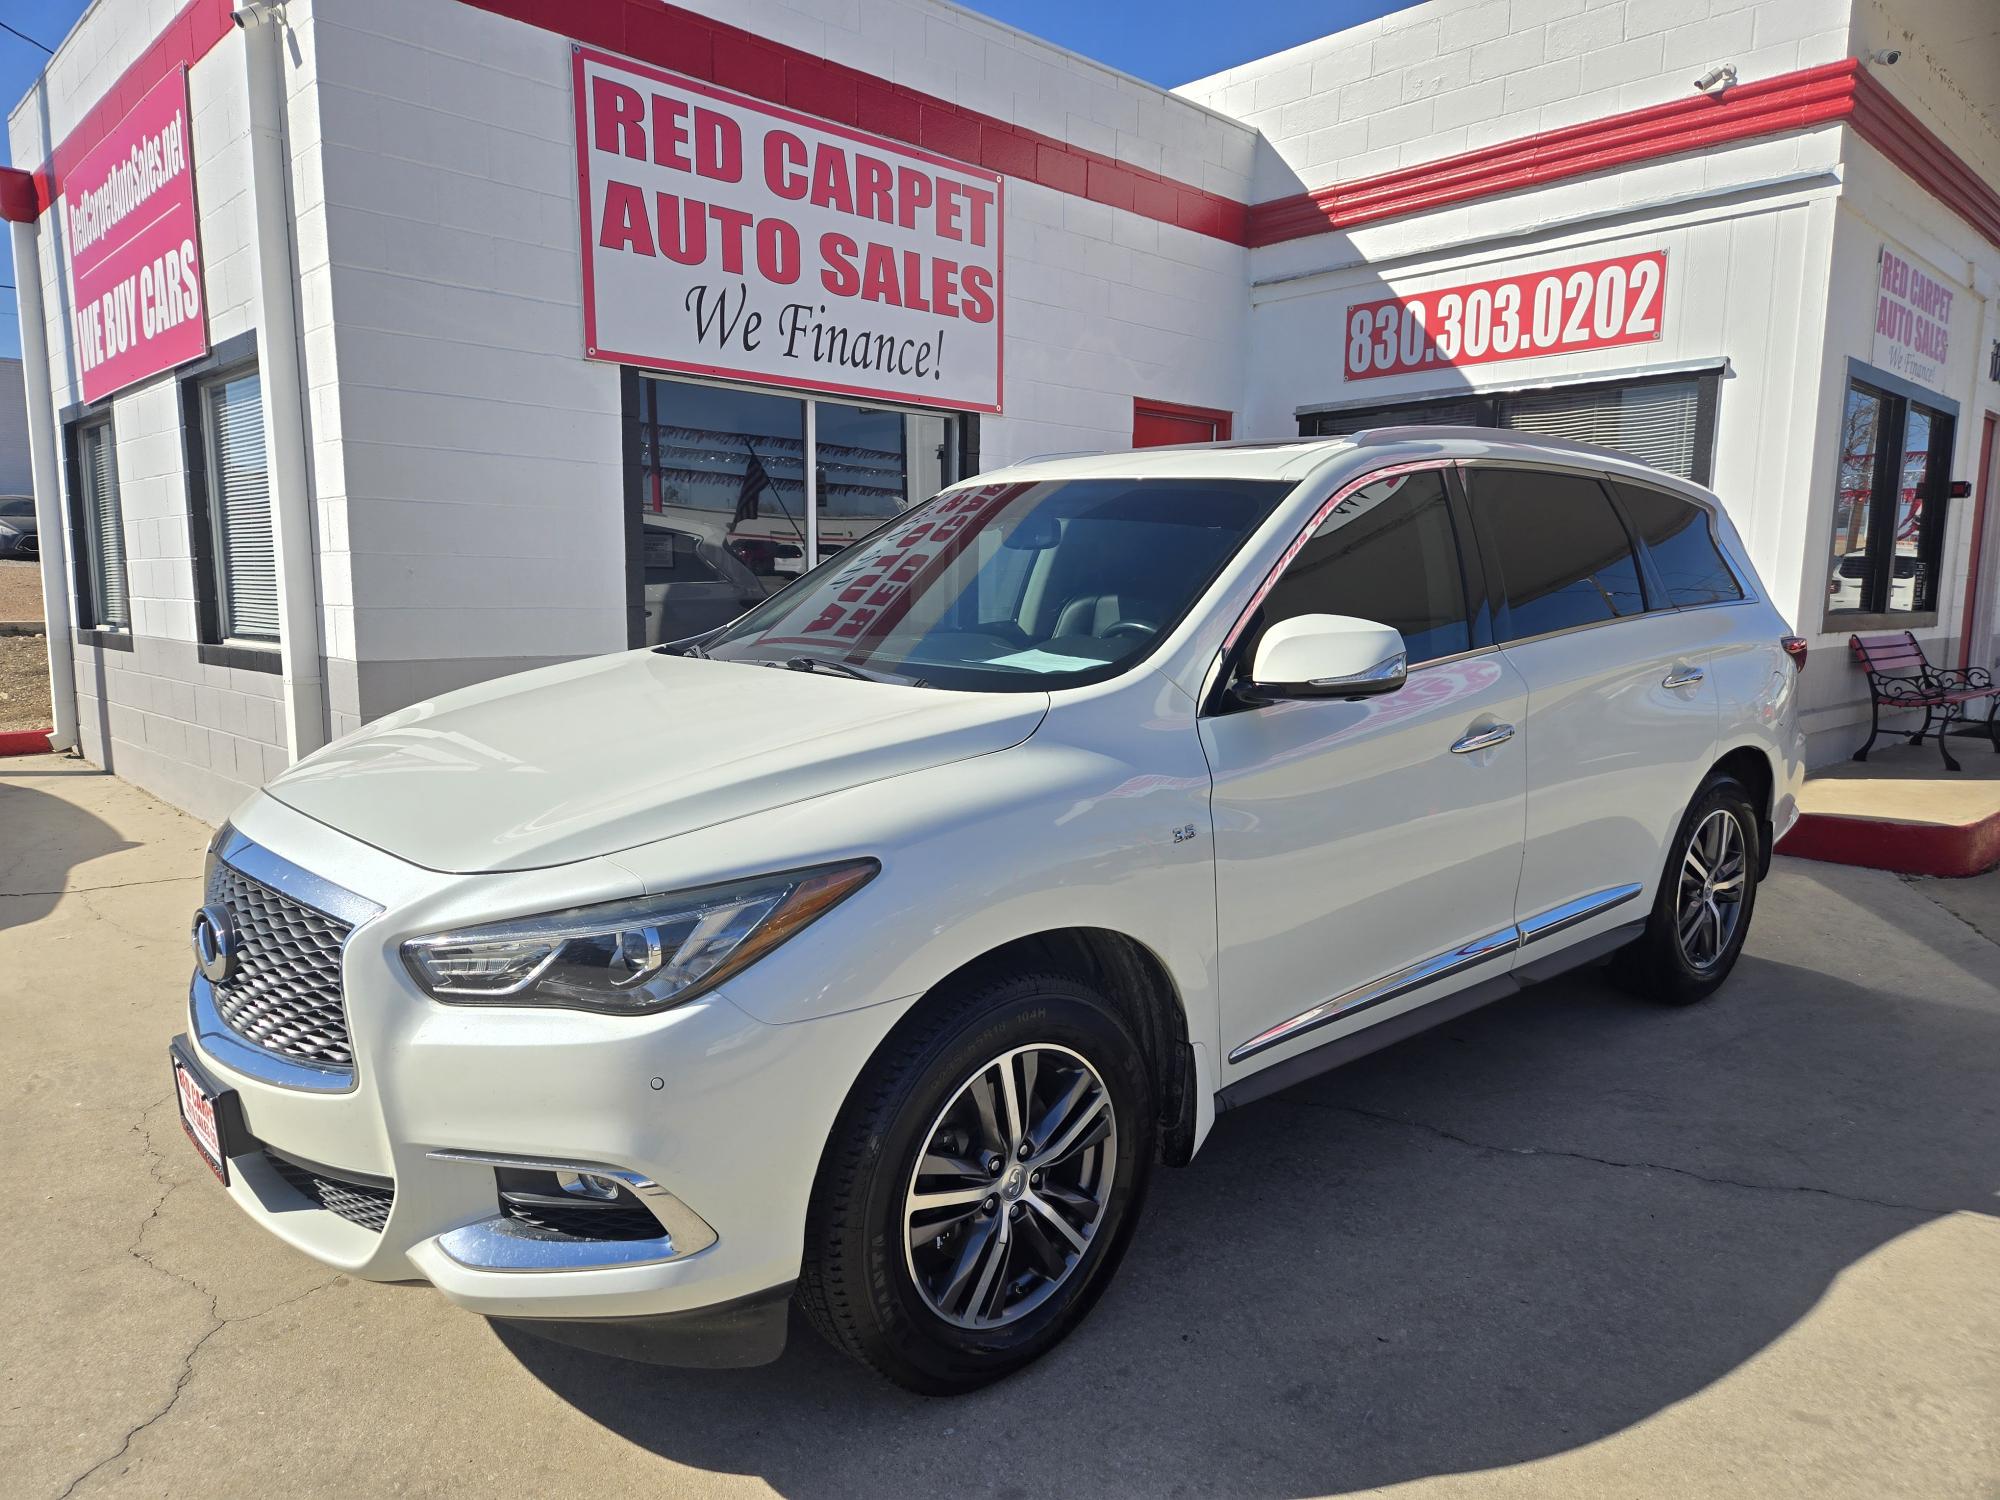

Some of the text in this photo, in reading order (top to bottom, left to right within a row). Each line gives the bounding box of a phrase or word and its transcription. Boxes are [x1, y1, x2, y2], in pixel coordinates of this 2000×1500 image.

[70, 108, 185, 256] RedCarpetAutoSales.net
[592, 75, 994, 248] RED CARPET
[78, 239, 199, 373] WE BUY CARS
[599, 180, 995, 323] AUTO SALES
[1881, 250, 1954, 324] RED CARPET
[685, 283, 945, 381] We Finance!
[1349, 260, 1660, 373] 830.303.0202
[1876, 296, 1948, 364] AUTO SALES
